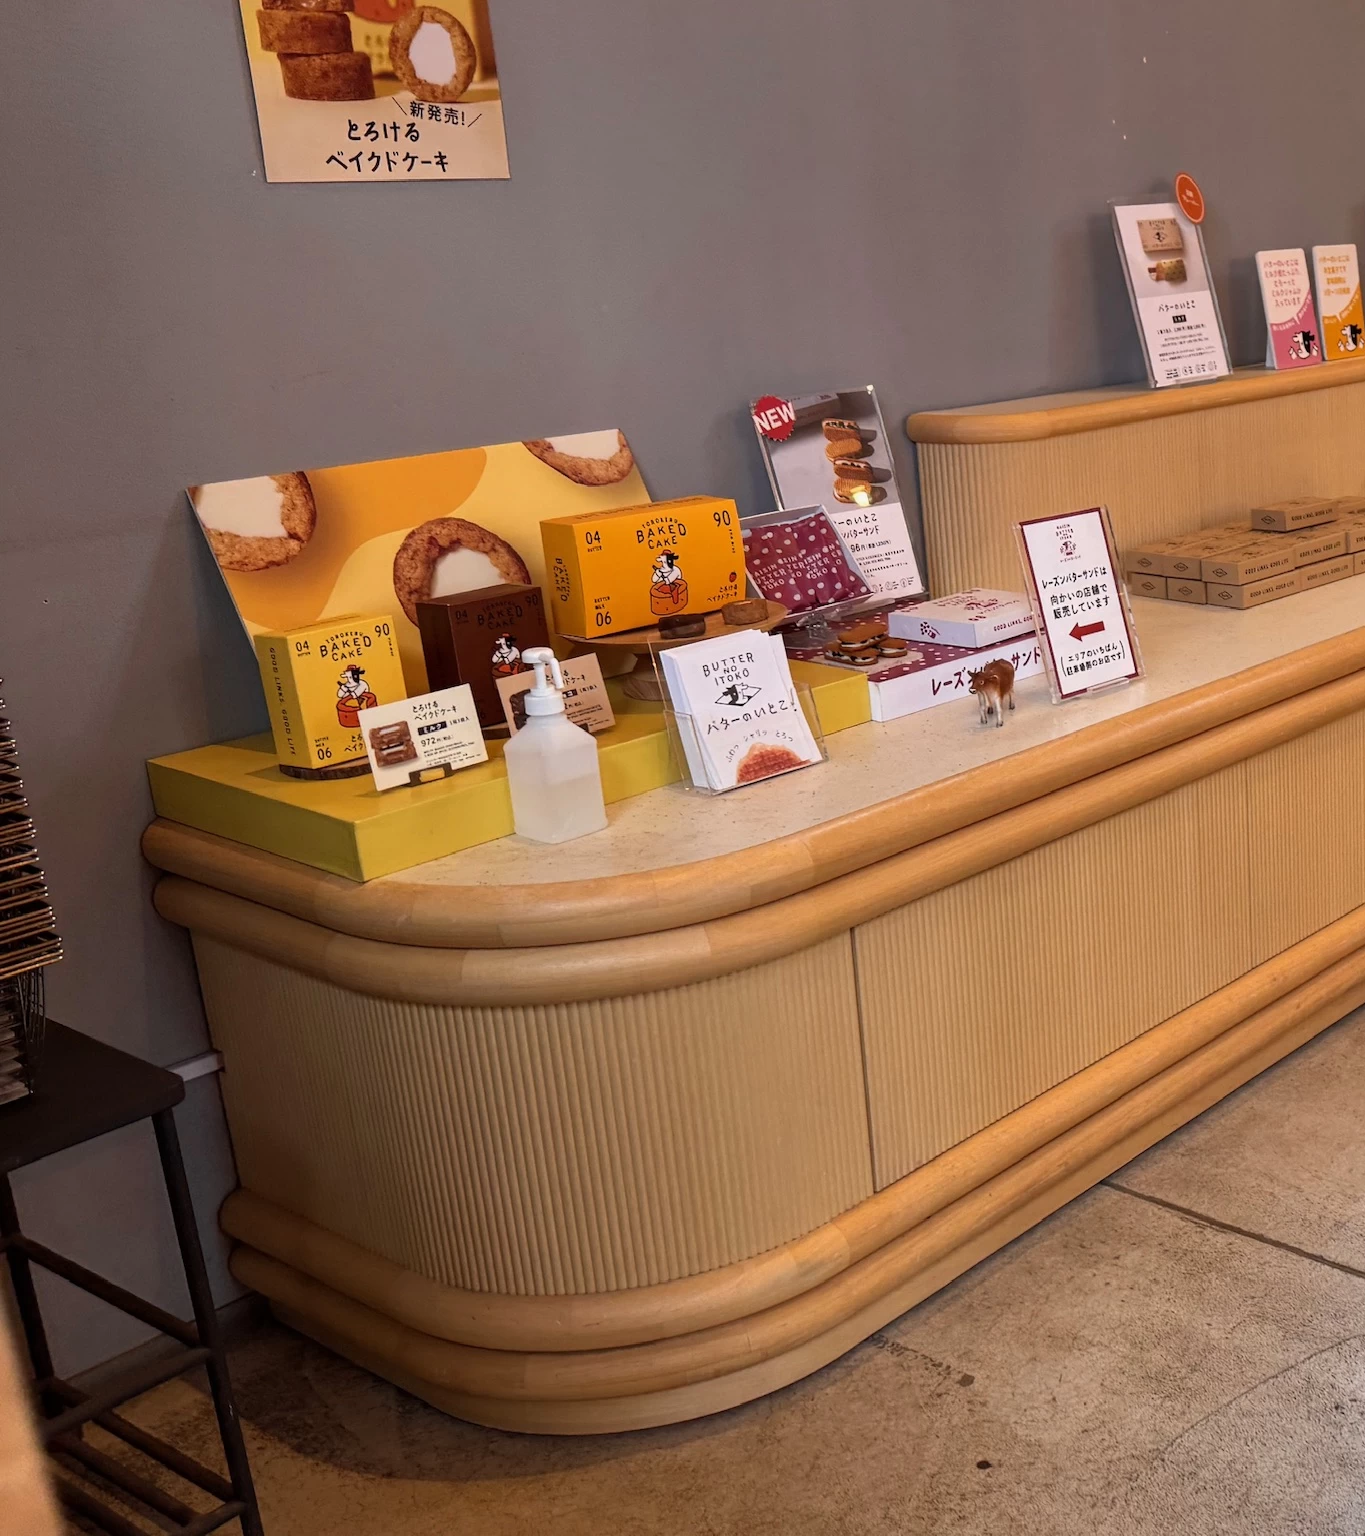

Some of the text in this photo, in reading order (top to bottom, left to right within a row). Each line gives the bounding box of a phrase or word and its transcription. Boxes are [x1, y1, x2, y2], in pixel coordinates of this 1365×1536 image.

[409, 100, 466, 126] 新発売!
[347, 119, 420, 143] とろける
[326, 150, 449, 173] ベイクドケーキ
[752, 402, 796, 434] NEW
[713, 510, 731, 527] 90
[834, 513, 878, 526] ーのいとこ
[585, 531, 601, 545] 04
[636, 523, 686, 544] BAKED
[841, 525, 880, 539] ンバターサンド
[648, 535, 678, 550] CAKE
[754, 563, 778, 578] AISIN
[756, 568, 787, 584] UTTER
[1041, 566, 1108, 589] レーズンバターサンドは
[762, 578, 785, 591] TOKO
[1050, 583, 1108, 606] 向かいの店舗で
[455, 609, 468, 621] 04
[477, 604, 523, 627] BAKED
[1053, 595, 1110, 620] 販売しています
[596, 611, 612, 627] 06
[374, 623, 390, 637] 90
[295, 640, 310, 652] 04
[320, 635, 372, 658] BAKED
[331, 647, 363, 661] CAKE
[1068, 642, 1118, 662] エリアのいちばん
[702, 652, 755, 678] BUTTER
[723, 665, 738, 675] NO
[931, 646, 1042, 696] レーズサンド
[563, 674, 586, 686] ドケーキ
[714, 668, 750, 687] ITOKO
[412, 701, 439, 713] とろける
[414, 705, 457, 721] ベイクドケーキ
[317, 747, 332, 760] 06
